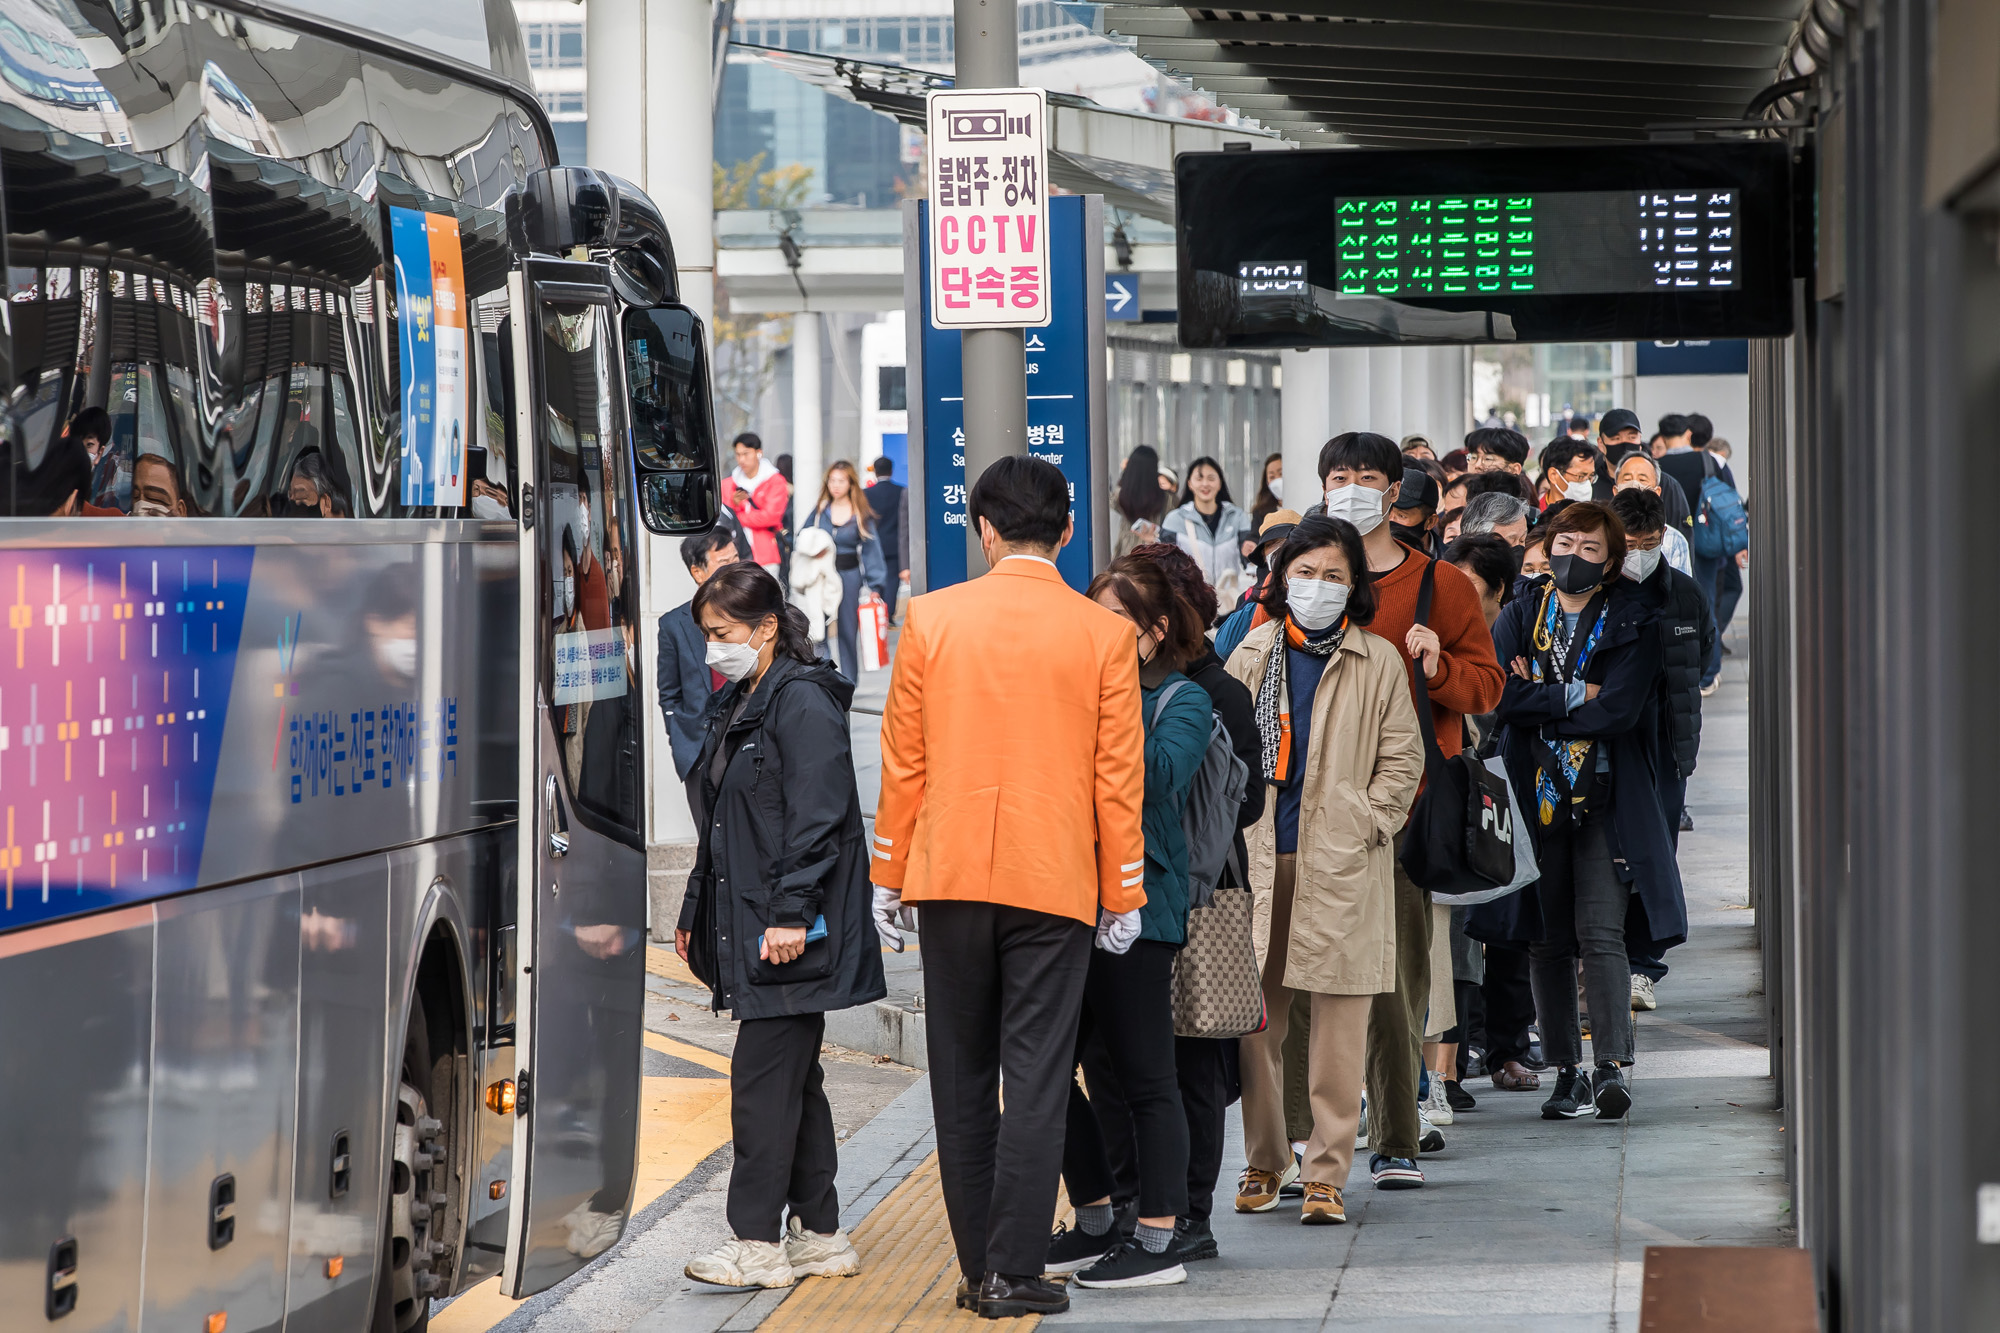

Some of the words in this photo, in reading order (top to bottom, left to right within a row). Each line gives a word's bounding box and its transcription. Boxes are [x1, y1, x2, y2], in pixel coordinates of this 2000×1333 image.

[939, 155, 1037, 207] 불법주·정차
[940, 214, 1037, 255] CCTV
[941, 265, 1040, 308] 단속중
[289, 712, 346, 804] 함께하는
[350, 707, 375, 794] 진료
[381, 701, 430, 789] 함께하는
[434, 697, 457, 783] 행복
